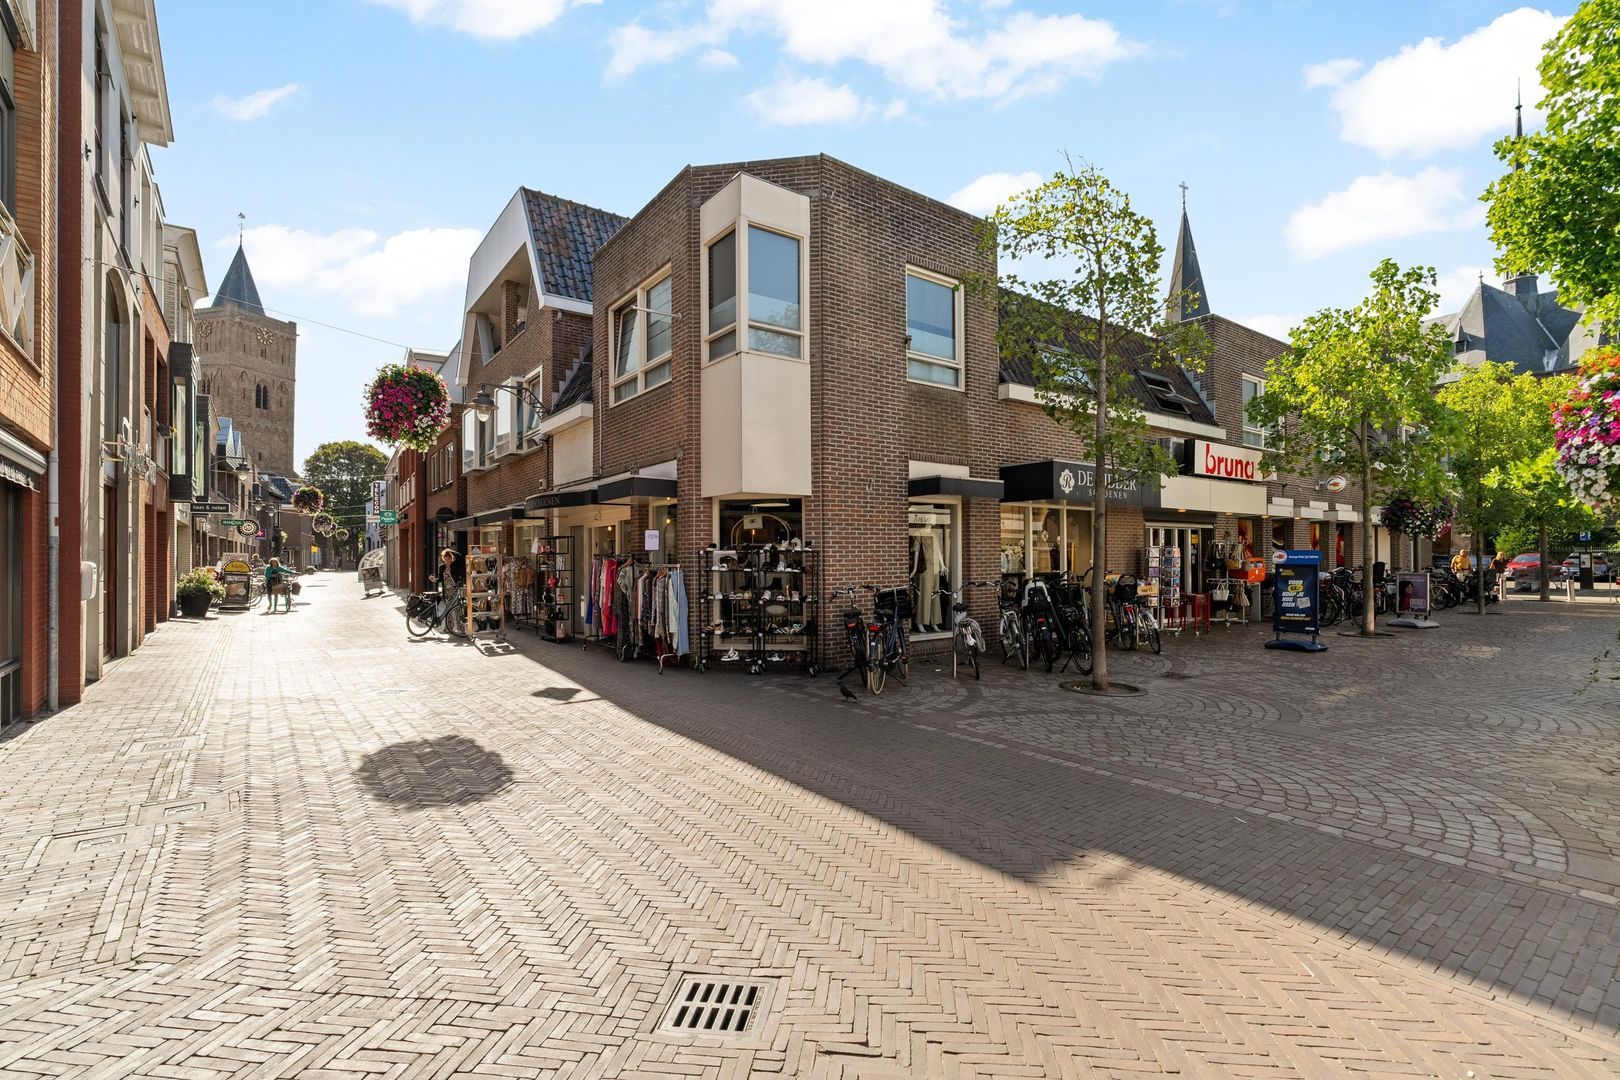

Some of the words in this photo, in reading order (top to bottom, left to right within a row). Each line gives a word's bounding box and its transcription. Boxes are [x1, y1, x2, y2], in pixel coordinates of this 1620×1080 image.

[1205, 443, 1254, 479] bruna
[1078, 470, 1094, 486] DE
[1104, 473, 1137, 491] IDDER
[1088, 488, 1128, 499] SCOENEN
